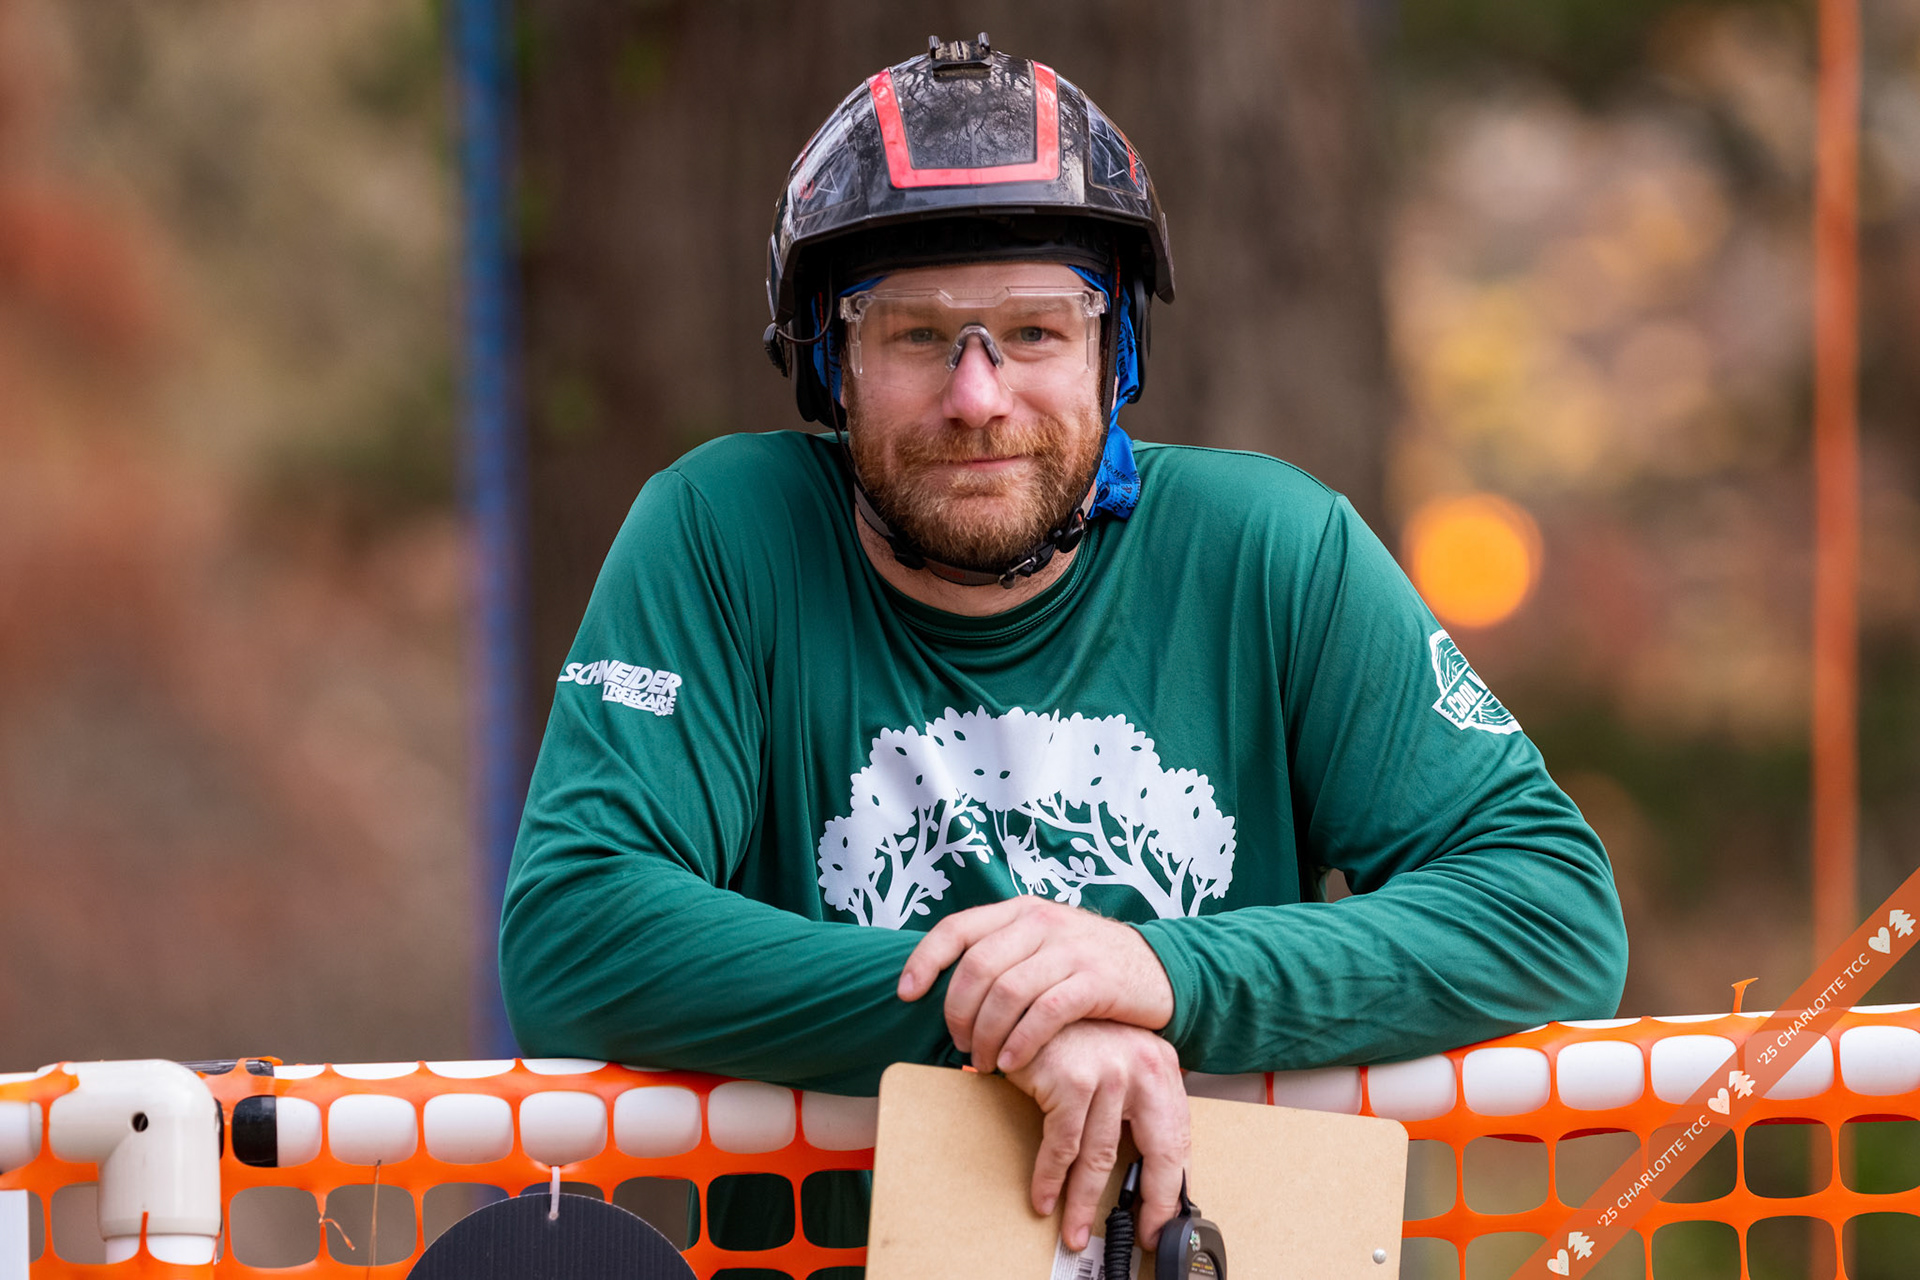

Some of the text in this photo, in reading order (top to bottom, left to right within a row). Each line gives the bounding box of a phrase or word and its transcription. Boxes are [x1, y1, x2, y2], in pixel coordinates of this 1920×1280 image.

[557, 660, 682, 697] SCHNEIDER
[602, 681, 676, 710] TREECARE
[1446, 680, 1483, 720] COOL
